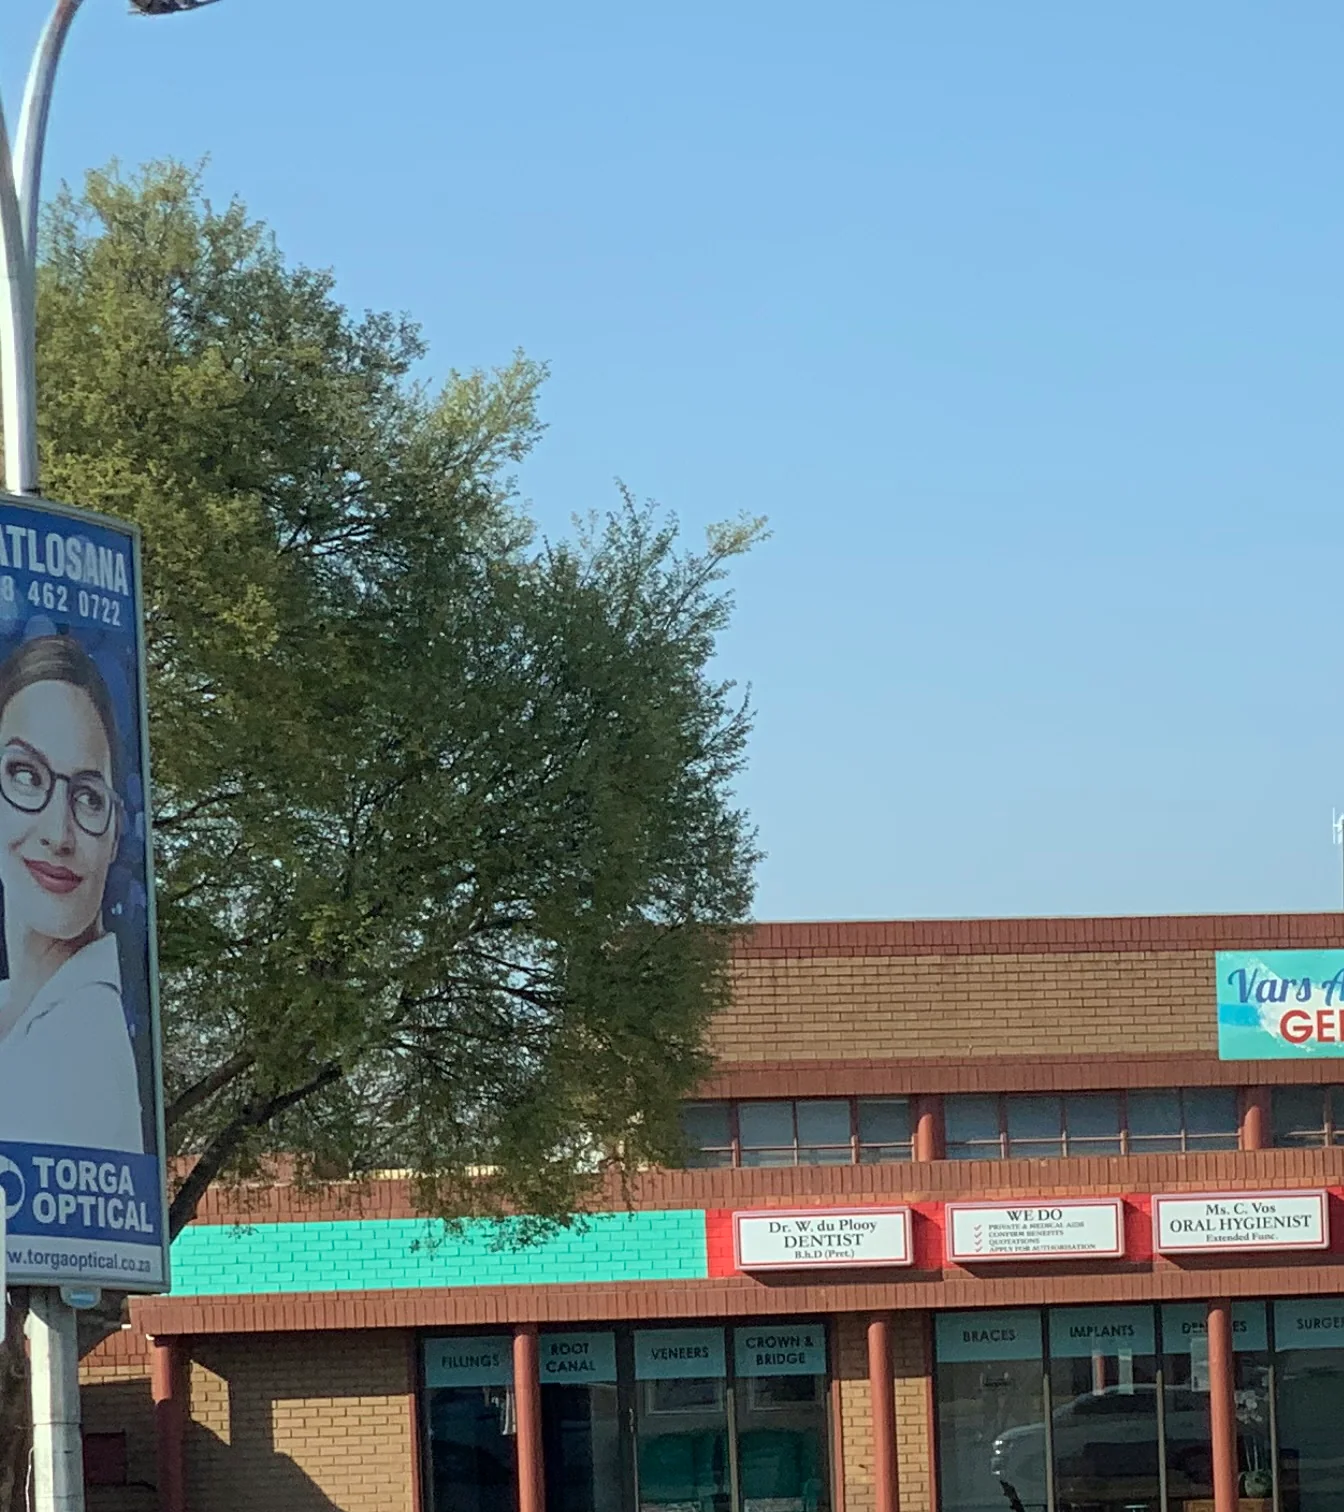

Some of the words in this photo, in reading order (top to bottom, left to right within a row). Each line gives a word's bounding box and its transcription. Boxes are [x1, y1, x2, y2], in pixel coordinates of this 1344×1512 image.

[0, 575, 14, 602] 8
[28, 580, 69, 612] 462
[78, 590, 121, 627] 0722
[1227, 967, 1312, 1003] Vars
[32, 1156, 135, 1196] TORGA
[32, 1192, 154, 1233] OPTICAL
[1006, 1210, 1034, 1221] WE
[1039, 1209, 1062, 1221] DO
[1206, 1204, 1230, 1215] Ms.
[1234, 1203, 1248, 1214] C.
[1252, 1202, 1276, 1213] Vos
[769, 1221, 791, 1233] Dr.
[795, 1220, 813, 1232] W.
[817, 1220, 834, 1232] du
[839, 1219, 877, 1233] Plooy
[1170, 1219, 1216, 1233] ORAL
[1220, 1215, 1312, 1230] HYGIENIST
[784, 1234, 864, 1248] DENTIST
[1206, 1233, 1249, 1242] Extended
[7, 1249, 151, 1272] w.torgaoptical.co.za
[963, 1330, 1016, 1343] BRACES
[1070, 1325, 1134, 1337] IMPLANTS
[746, 1336, 799, 1348] CROWN
[804, 1336, 813, 1347] &
[551, 1343, 589, 1355] ROOT
[651, 1347, 708, 1360] VENEERS
[442, 1354, 499, 1368] FILLINGS
[756, 1352, 806, 1365] BRIDGE
[546, 1361, 595, 1372] CANAL
